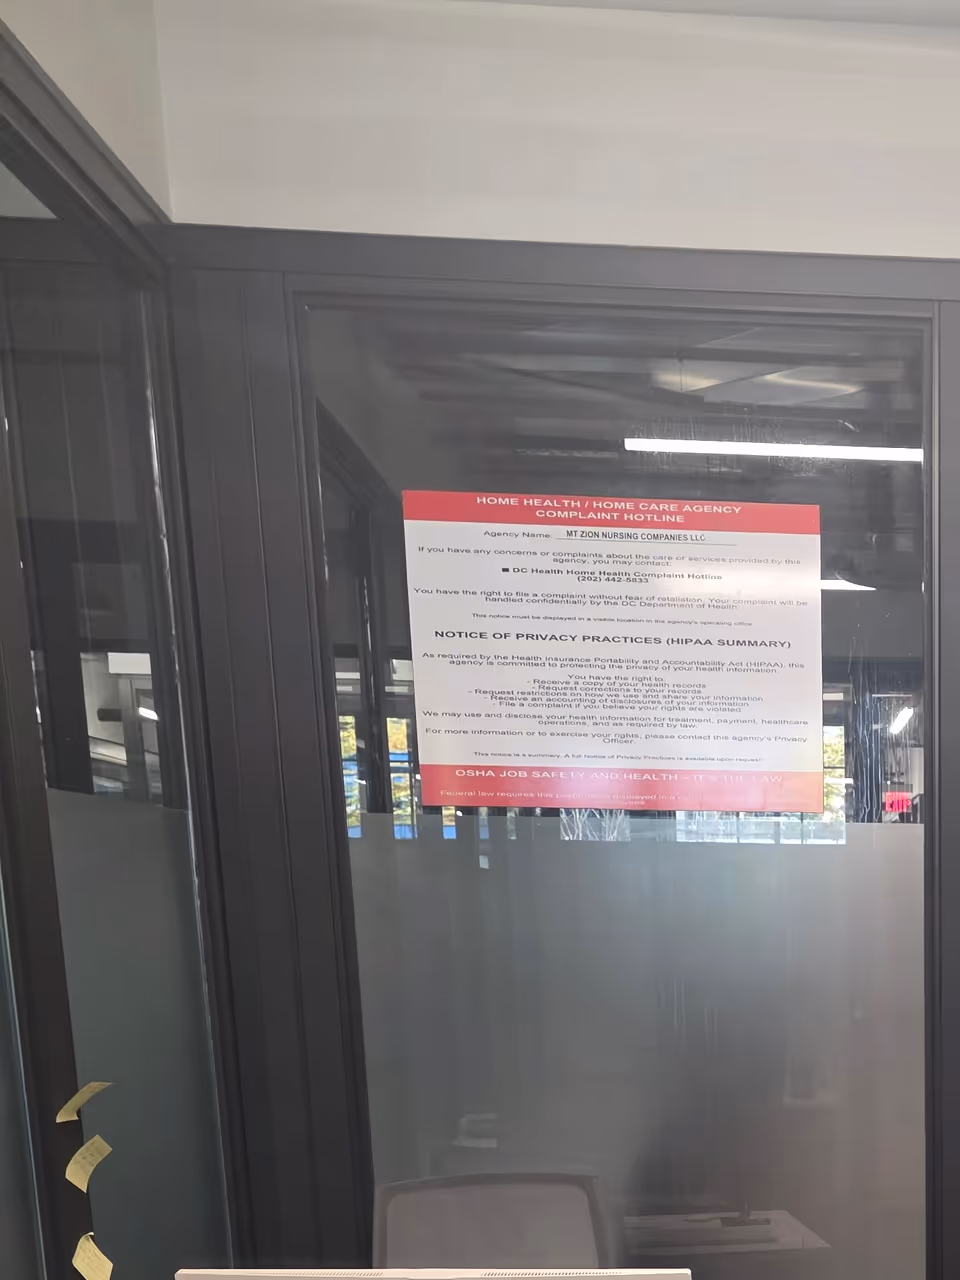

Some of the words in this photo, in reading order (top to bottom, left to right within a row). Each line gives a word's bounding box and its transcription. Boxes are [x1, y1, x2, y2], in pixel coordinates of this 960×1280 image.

[476, 496, 519, 505] HOME
[522, 498, 581, 507] HEALTH
[592, 501, 634, 509] HOME
[638, 502, 678, 511] CARE
[683, 504, 741, 513] AGENCY
[536, 510, 620, 520] COMPLAINT
[623, 513, 684, 522] HOTLINE
[435, 630, 488, 639] NOTICE
[515, 633, 578, 641] PRIVACY
[581, 635, 662, 644] PRACTICES
[666, 637, 713, 646] (HIPAA
[717, 639, 791, 649] SUMMARY)
